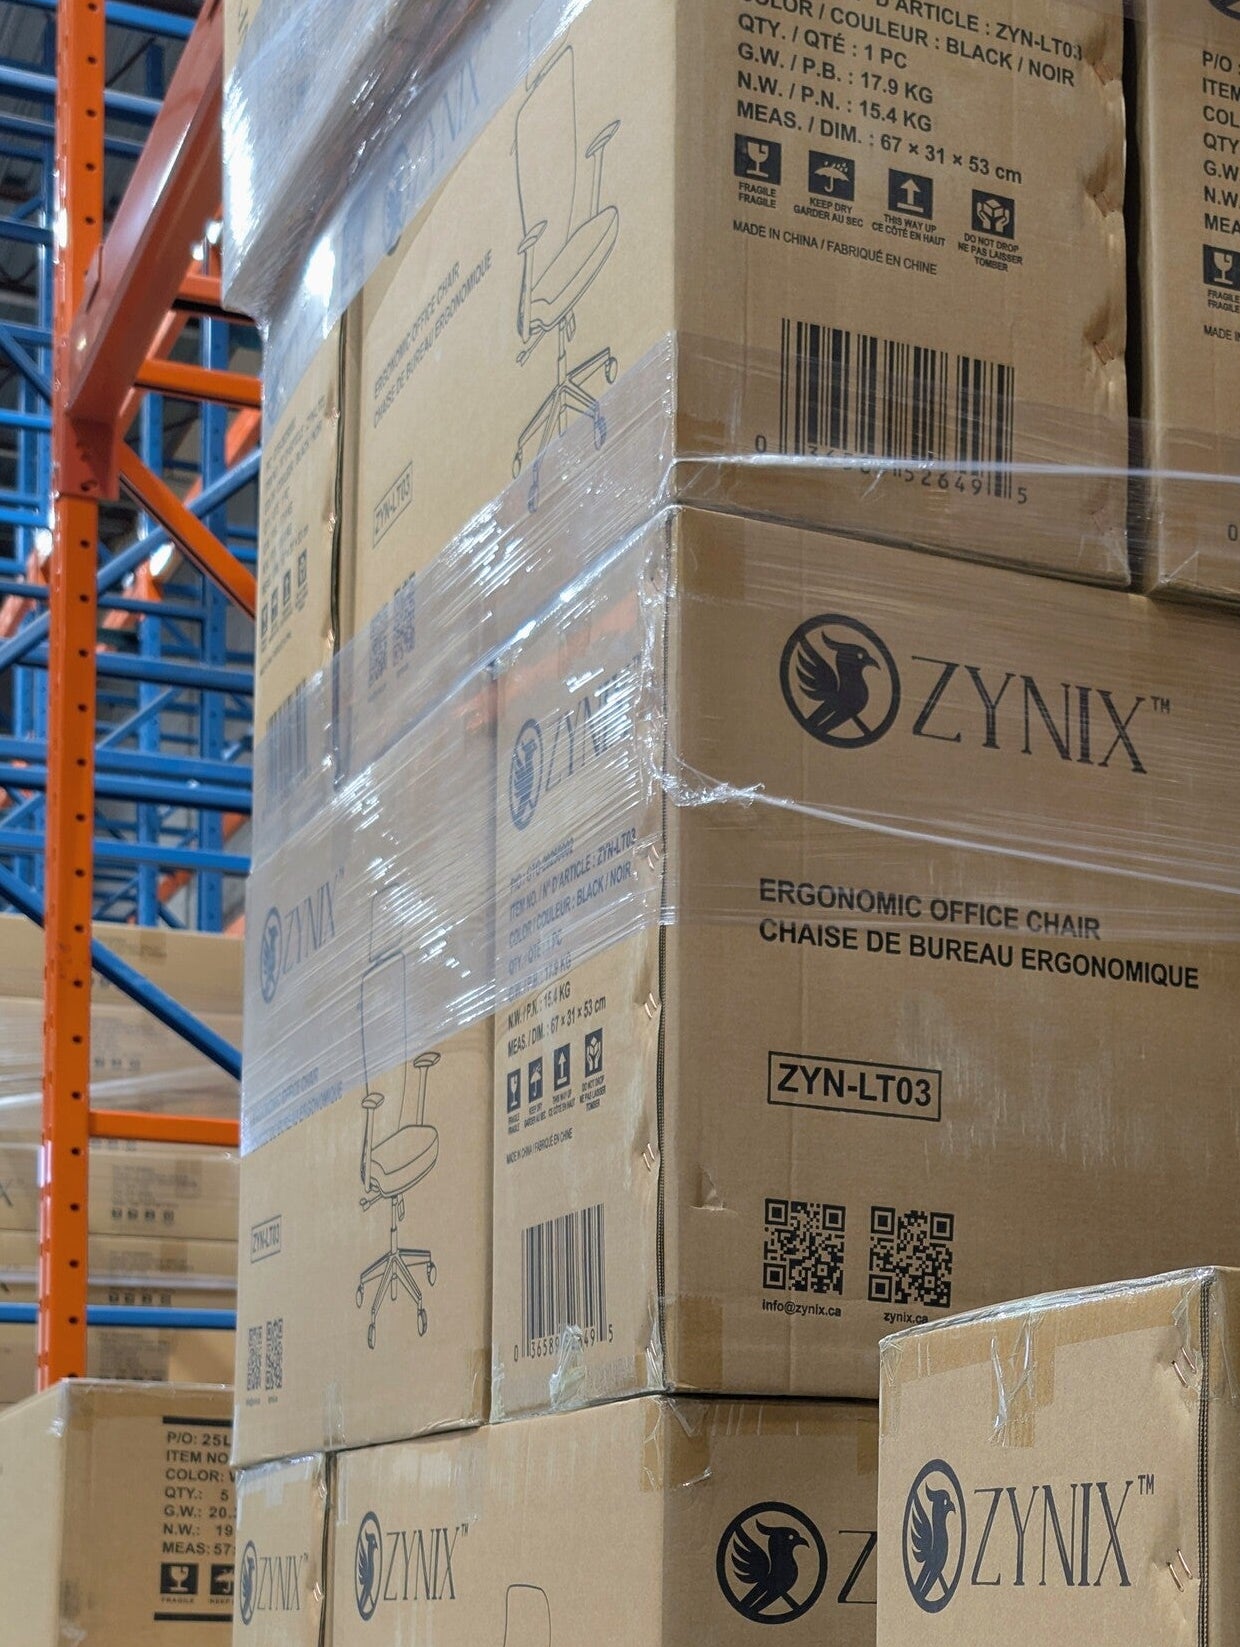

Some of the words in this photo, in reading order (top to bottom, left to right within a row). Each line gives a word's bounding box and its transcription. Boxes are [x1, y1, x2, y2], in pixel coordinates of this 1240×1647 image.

[830, 8, 928, 47] COULEUR
[946, 37, 1013, 68] BLACK
[1029, 59, 1075, 87] NOIR
[738, 43, 784, 68] G.W.
[803, 57, 841, 81] P.B.
[861, 72, 898, 95] 17.9
[905, 82, 933, 104] KG
[1202, 50, 1232, 72] P/O
[1227, 524, 1238, 542] 0
[760, 878, 922, 918] ERGONOMIC
[930, 900, 1019, 928] OFFICE
[1026, 910, 1100, 940] CHAIR
[759, 919, 858, 950] CHAISE
[867, 930, 901, 954] DE
[910, 934, 1013, 967] BUREAU
[1022, 948, 1199, 989] ERGONOMIQUE
[777, 1062, 932, 1107] ZYN-LT03
[762, 1299, 841, 1316] info@zynix.ca
[884, 1312, 928, 1324] zynix.ca
[167, 1450, 201, 1462] ITEM
[166, 1468, 224, 1482] COLOR:
[209, 1506, 236, 1518] 20.
